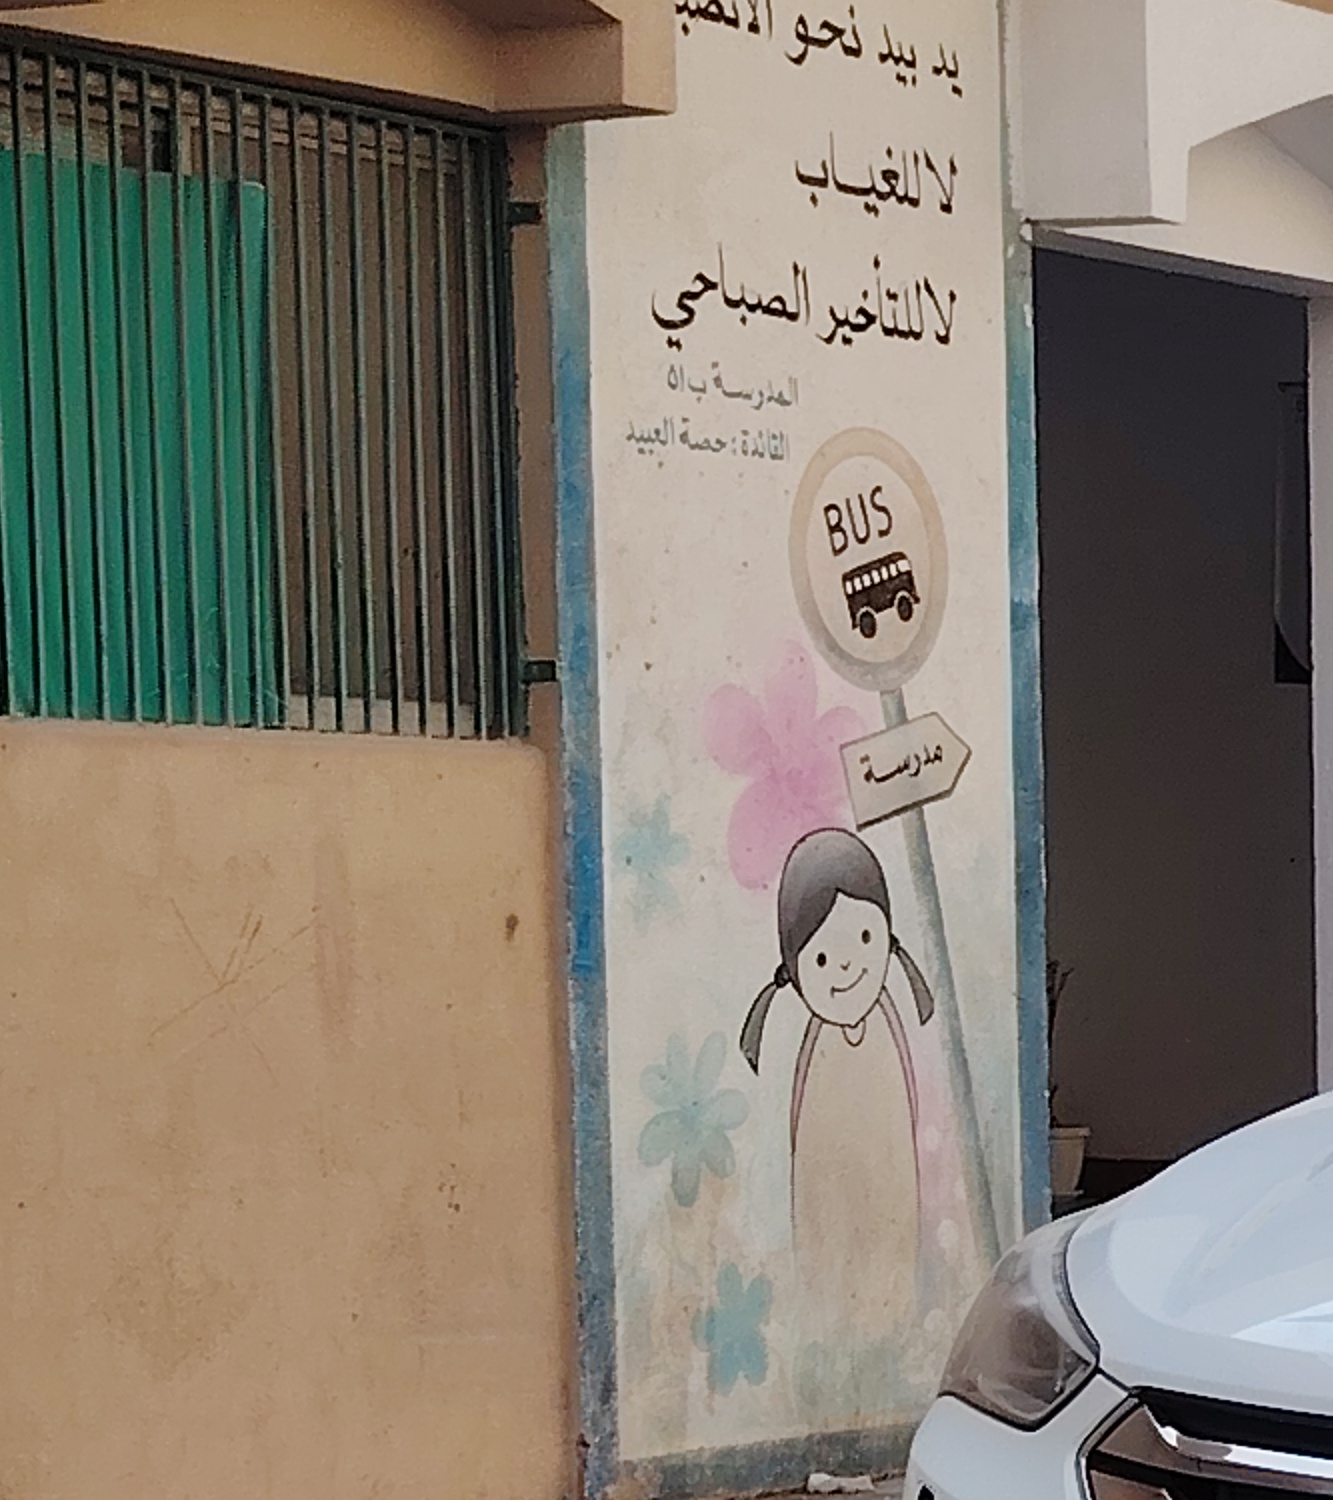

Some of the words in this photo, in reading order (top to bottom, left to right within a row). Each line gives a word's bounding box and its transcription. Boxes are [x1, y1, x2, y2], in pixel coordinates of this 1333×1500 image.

[784, 4, 863, 66] نحو
[878, 23, 917, 88] بيد
[651, 241, 811, 352] الصباحي
[823, 485, 893, 557] BUS
[859, 743, 944, 784] مدرسة
